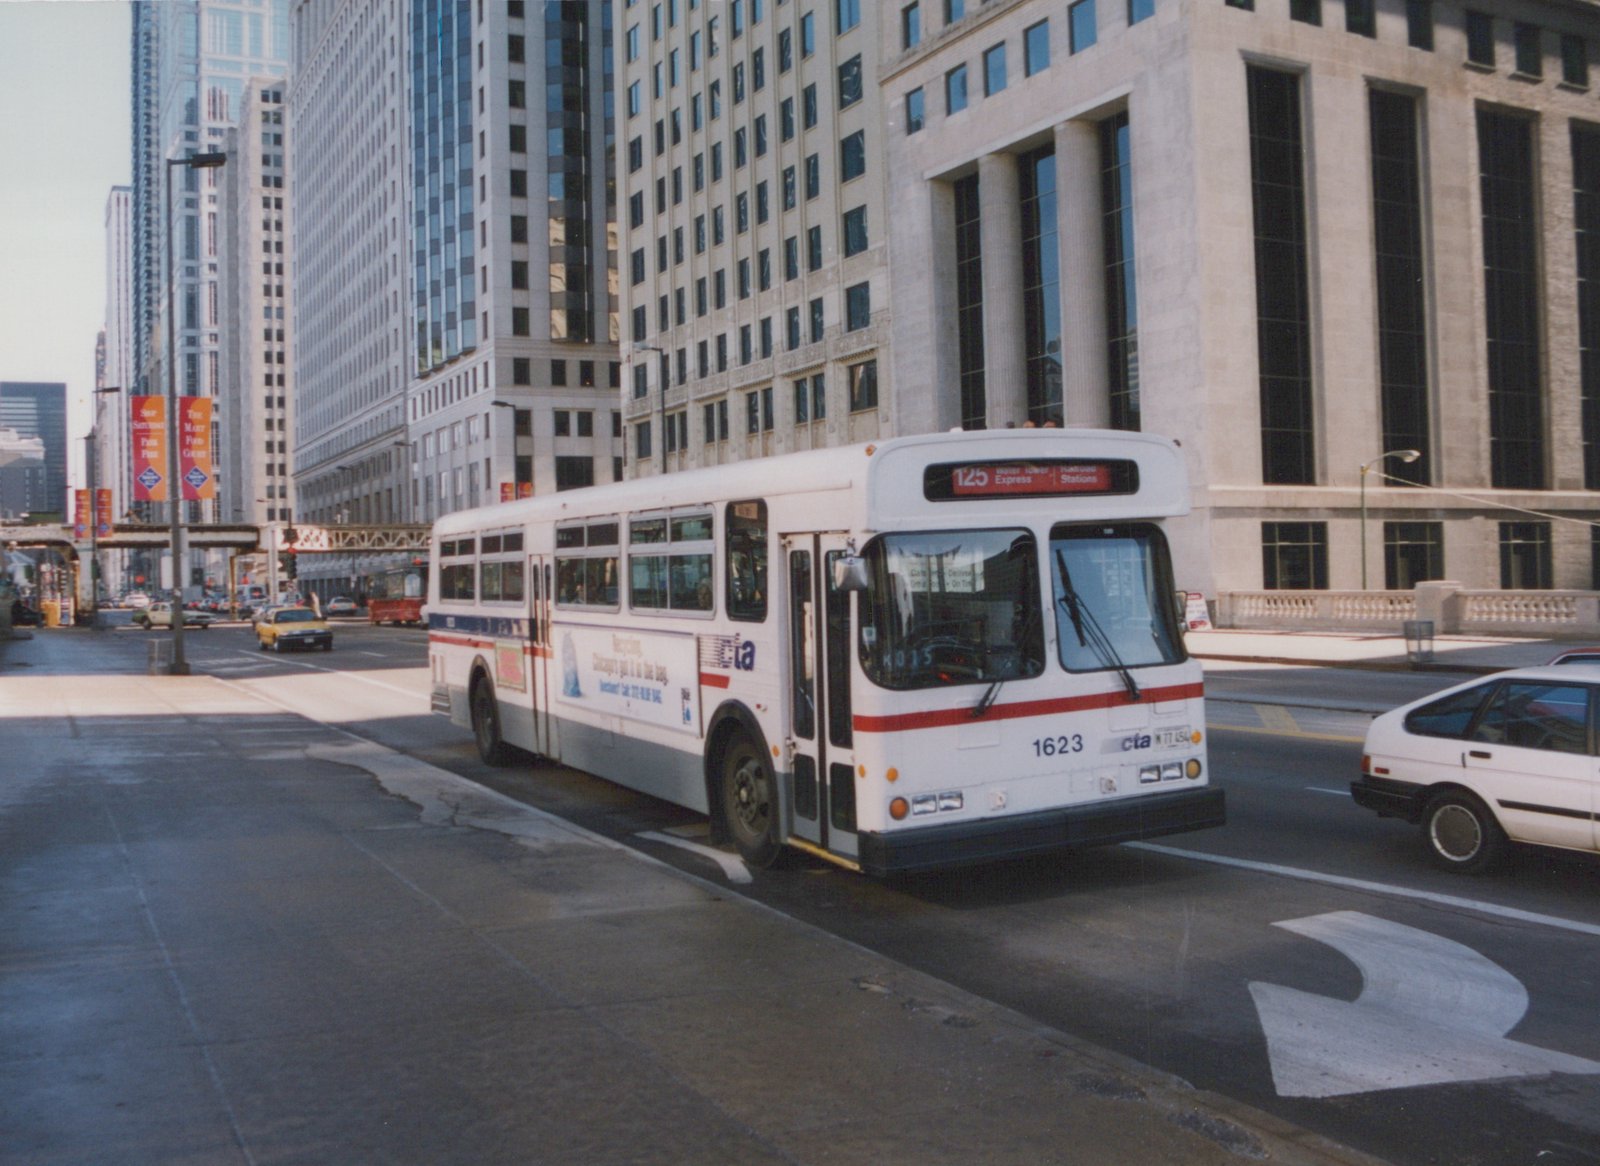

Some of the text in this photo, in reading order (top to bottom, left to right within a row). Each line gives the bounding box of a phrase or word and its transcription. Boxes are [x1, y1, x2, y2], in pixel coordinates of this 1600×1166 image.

[184, 422, 206, 433] MART
[954, 468, 989, 486] 125
[995, 475, 1032, 485] Express
[1061, 474, 1098, 484] Stations
[1033, 733, 1084, 757] 1623
[1121, 733, 1152, 752] cta
